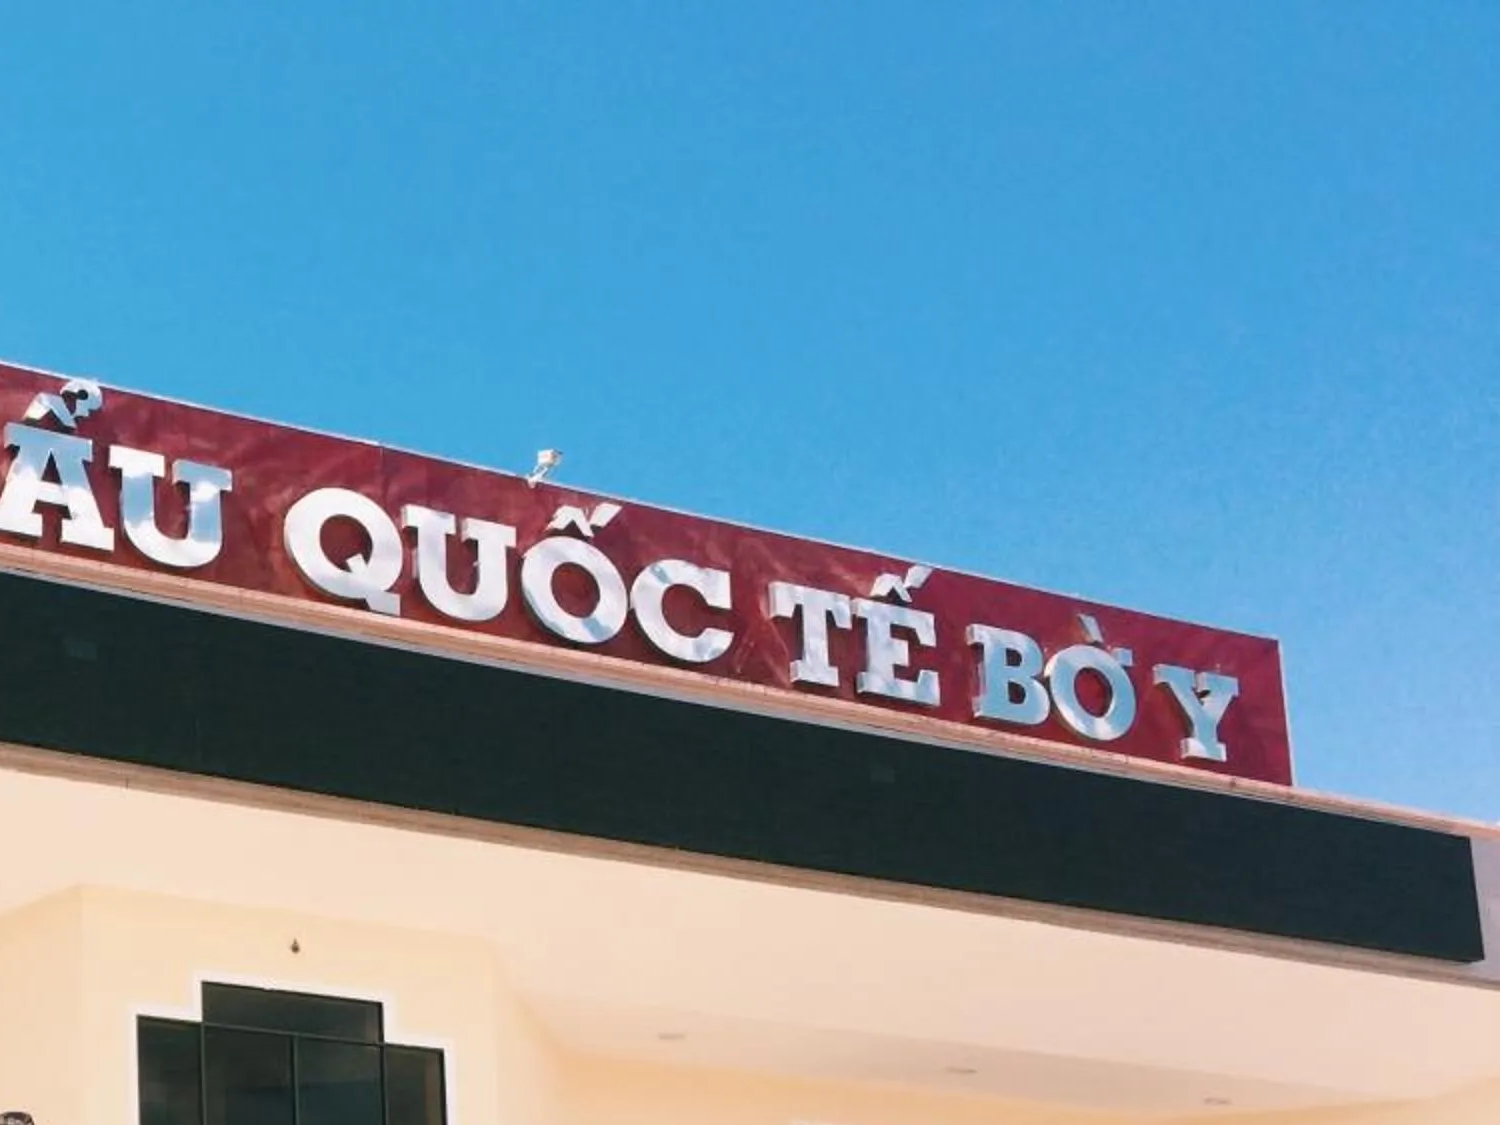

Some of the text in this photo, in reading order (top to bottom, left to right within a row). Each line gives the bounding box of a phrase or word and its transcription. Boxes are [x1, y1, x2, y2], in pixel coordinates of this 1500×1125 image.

[284, 487, 735, 663] QUỐC
[768, 565, 940, 706] TẾ
[966, 613, 1136, 741] BỜ
[1153, 663, 1239, 762] Y
